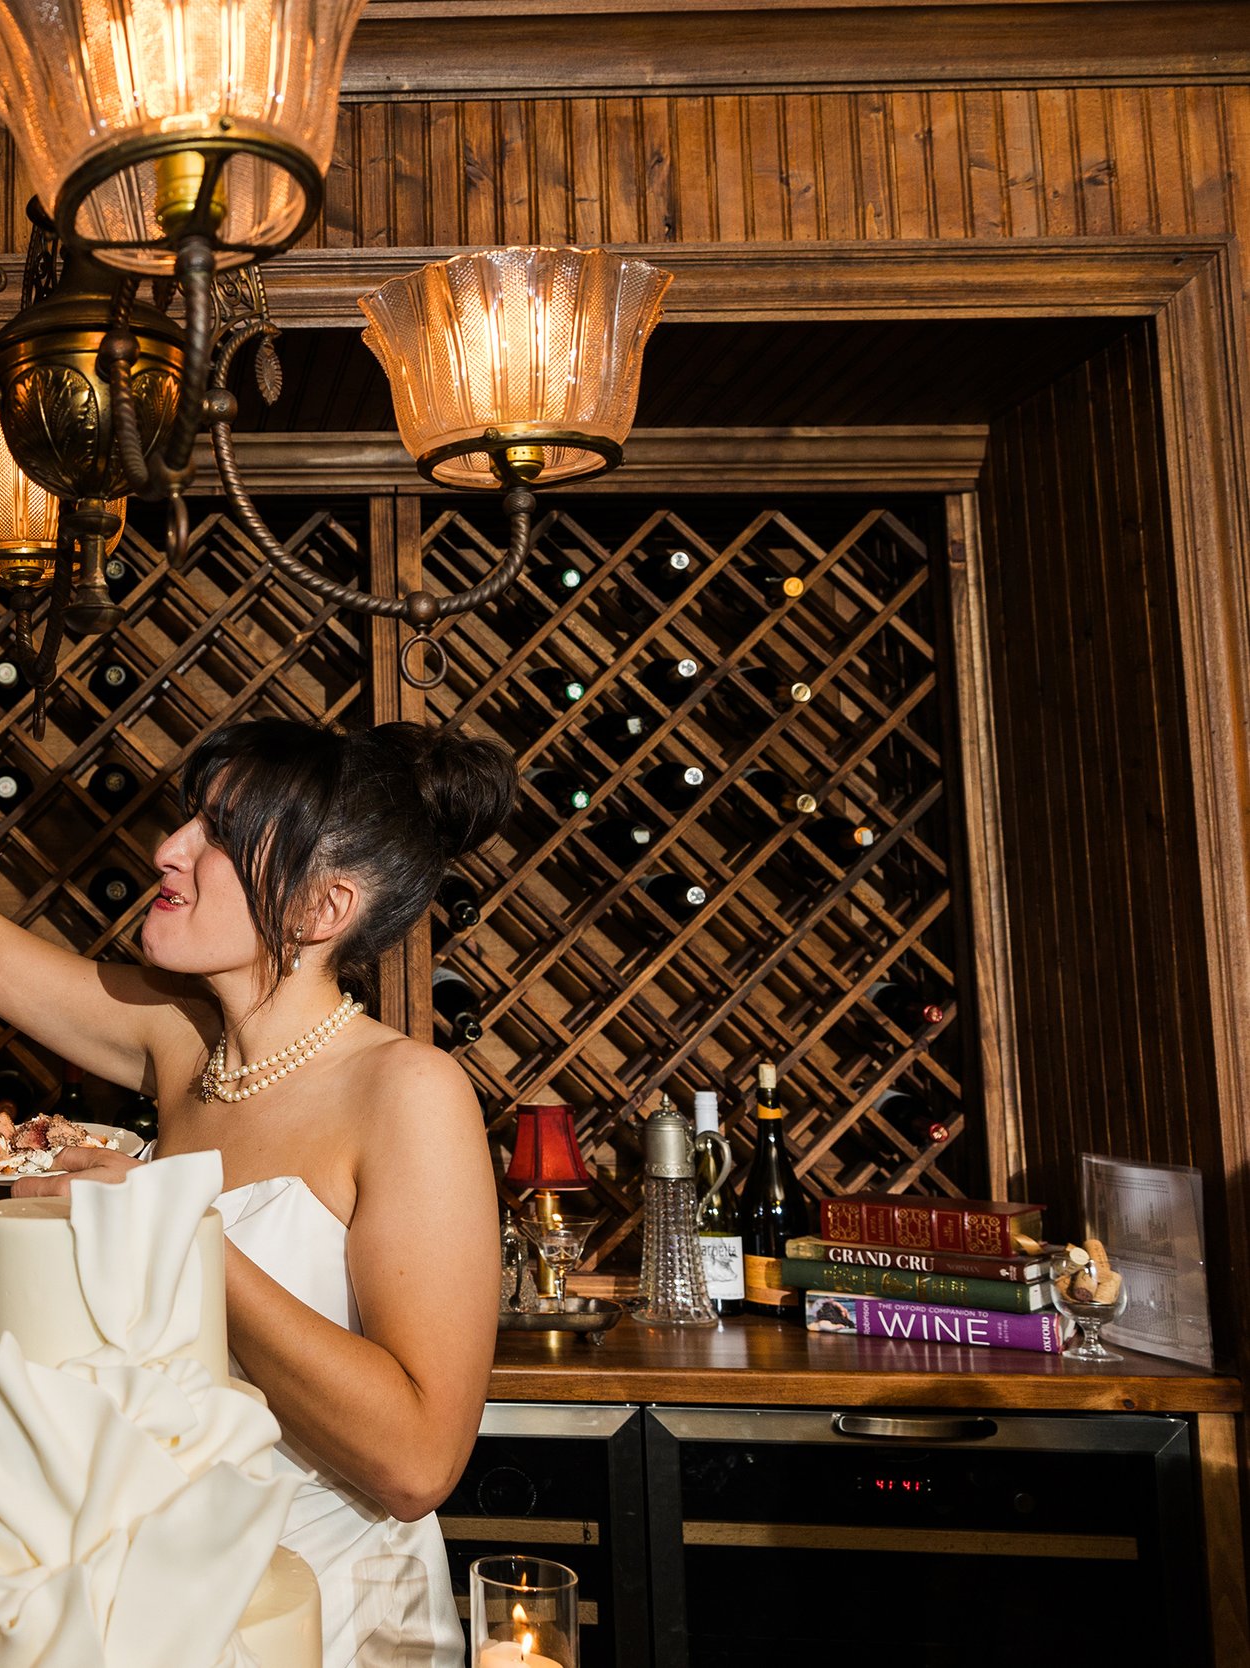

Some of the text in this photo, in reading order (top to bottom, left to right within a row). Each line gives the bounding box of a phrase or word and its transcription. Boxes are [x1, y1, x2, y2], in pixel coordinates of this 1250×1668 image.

[828, 1247, 934, 1272] GRAND CRU
[946, 1263, 981, 1273] NORMAN
[862, 1301, 871, 1335] Robinson
[894, 1304, 927, 1312] OXFORD
[928, 1306, 976, 1317] COMPANION
[978, 1310, 990, 1318] TO
[877, 1311, 991, 1346] WINE
[1040, 1316, 1051, 1352] OXFORD
[876, 1479, 920, 1491] 41 41
